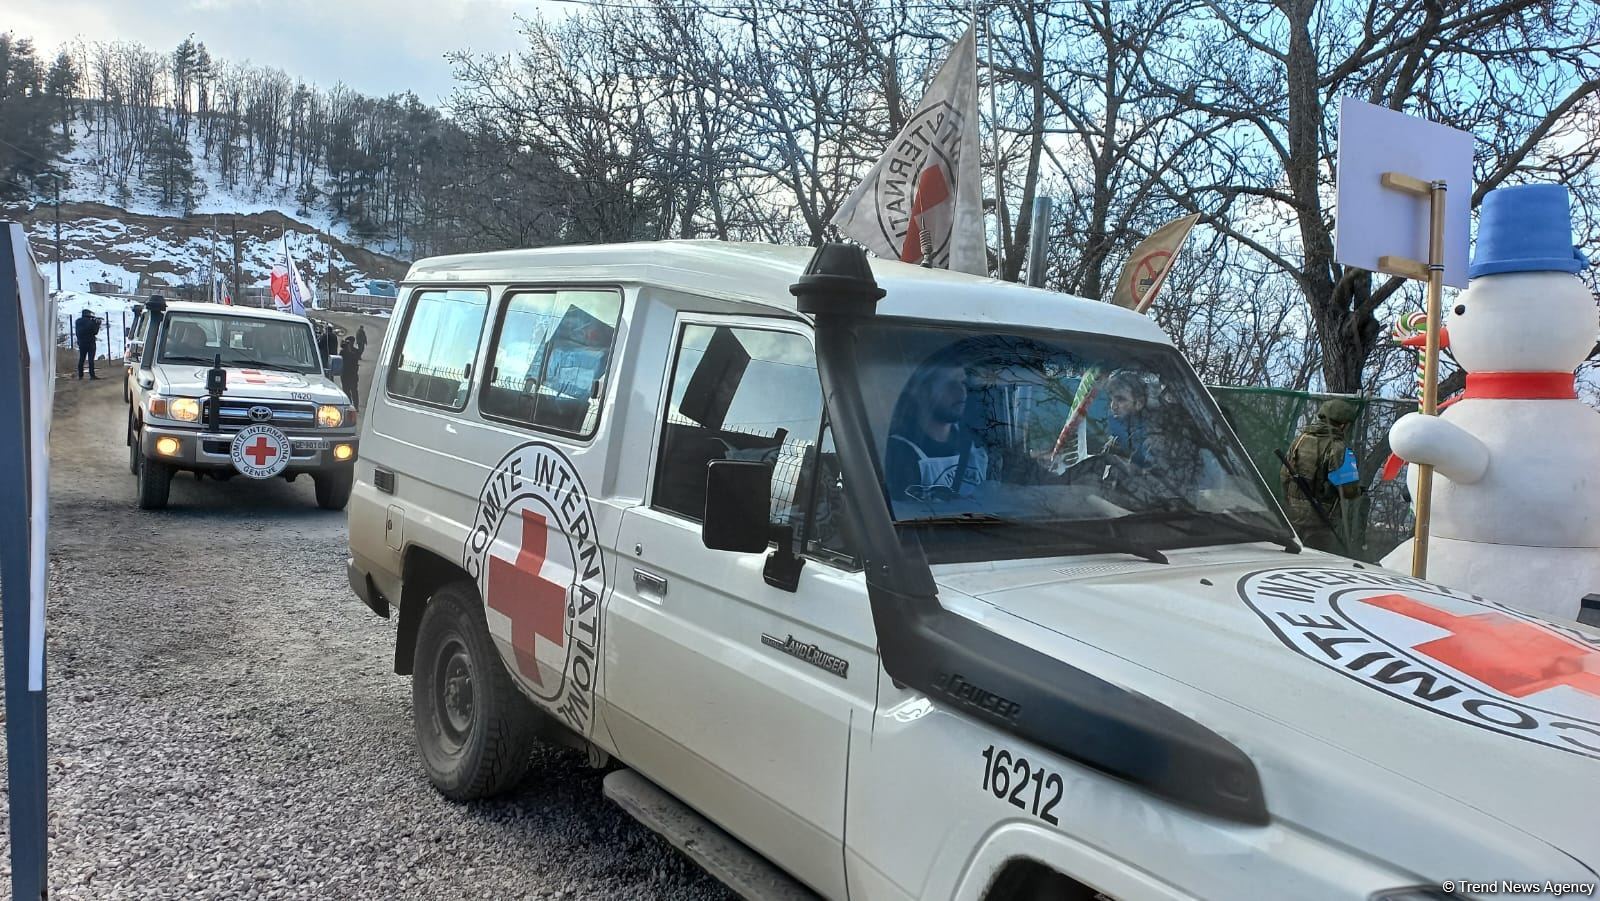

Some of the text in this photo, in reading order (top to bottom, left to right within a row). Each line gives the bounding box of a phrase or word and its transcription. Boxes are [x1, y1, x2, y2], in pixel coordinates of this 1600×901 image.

[290, 392, 312, 401] 17420
[233, 426, 289, 463] COMITE INTERNATIONAL
[243, 466, 277, 477] GENEVE
[467, 457, 523, 580] COMITE
[1276, 611, 1600, 753] COMITE
[982, 745, 1064, 826] 16212
